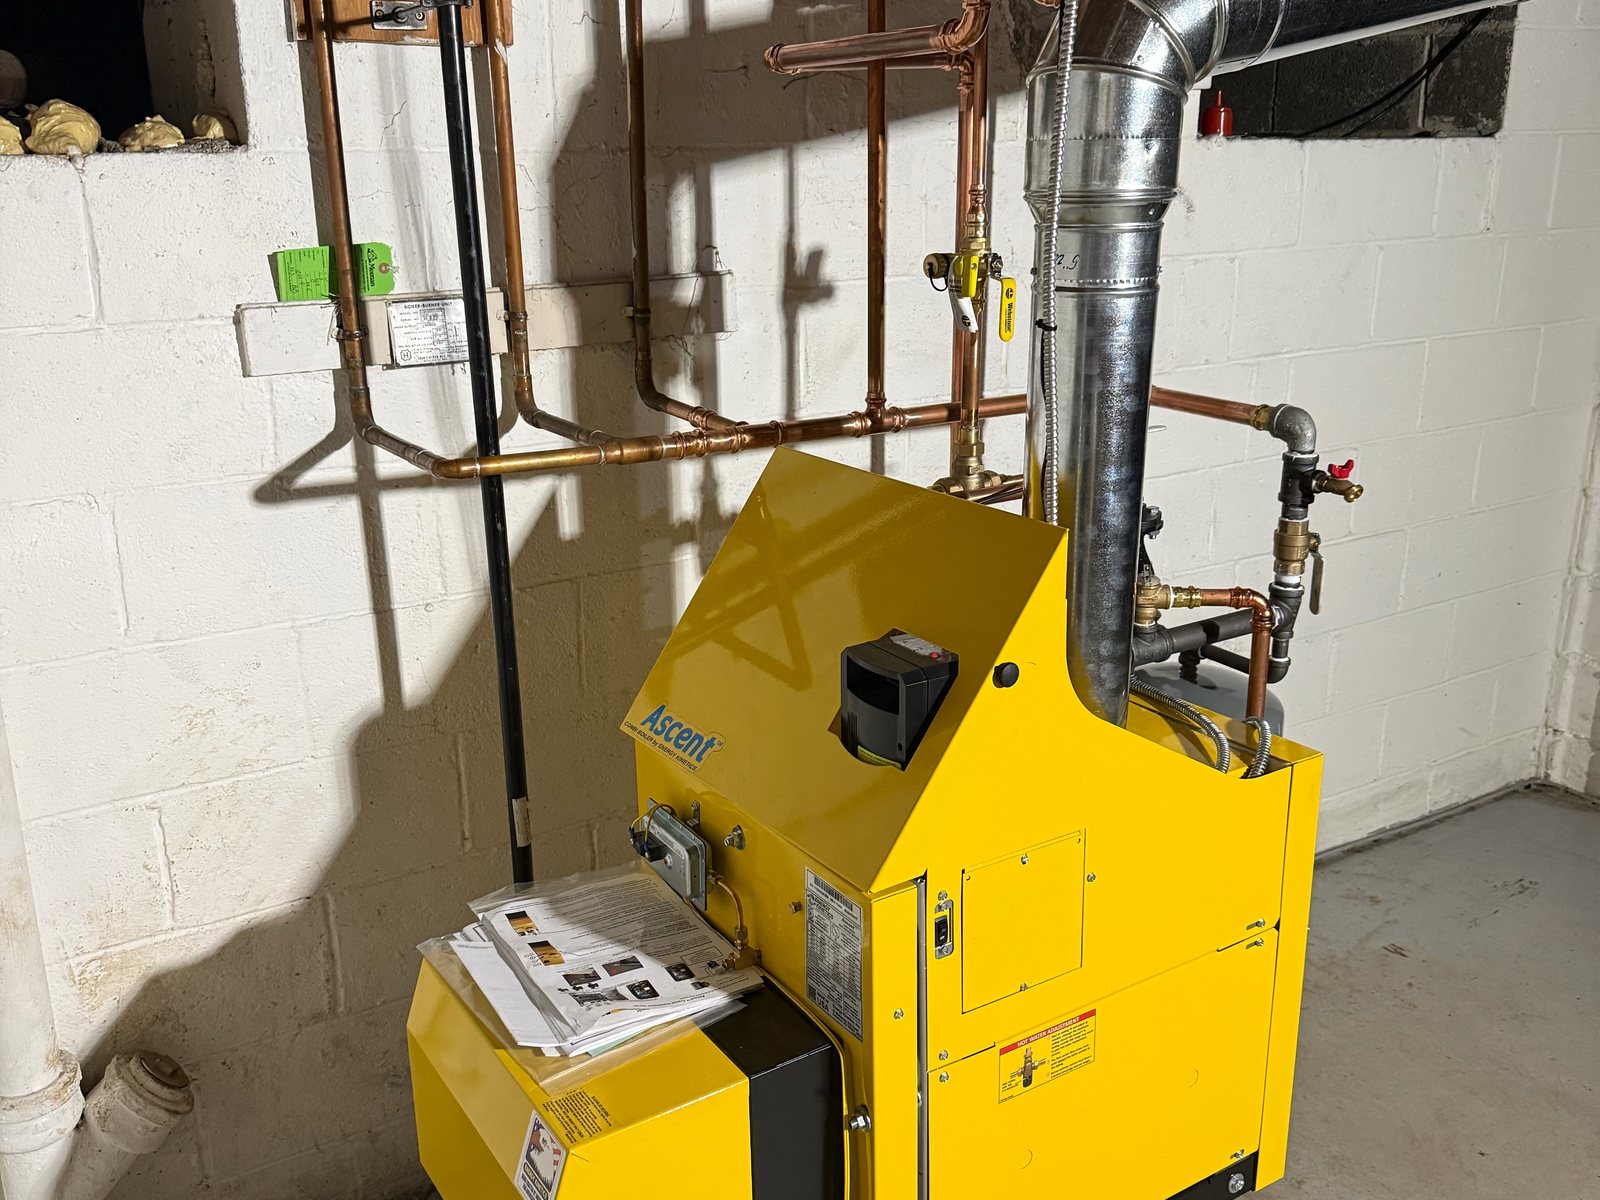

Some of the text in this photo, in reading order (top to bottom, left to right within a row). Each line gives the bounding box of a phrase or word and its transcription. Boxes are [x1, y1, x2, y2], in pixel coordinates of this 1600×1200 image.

[623, 721, 638, 733] COMBI
[636, 729, 653, 743] BOILER
[657, 743, 677, 757] ENERGY
[674, 755, 698, 772] KINETICS
[640, 704, 717, 763] Ascent
[1017, 1016, 1081, 1047] HOT WATER ADJUSTMENT
